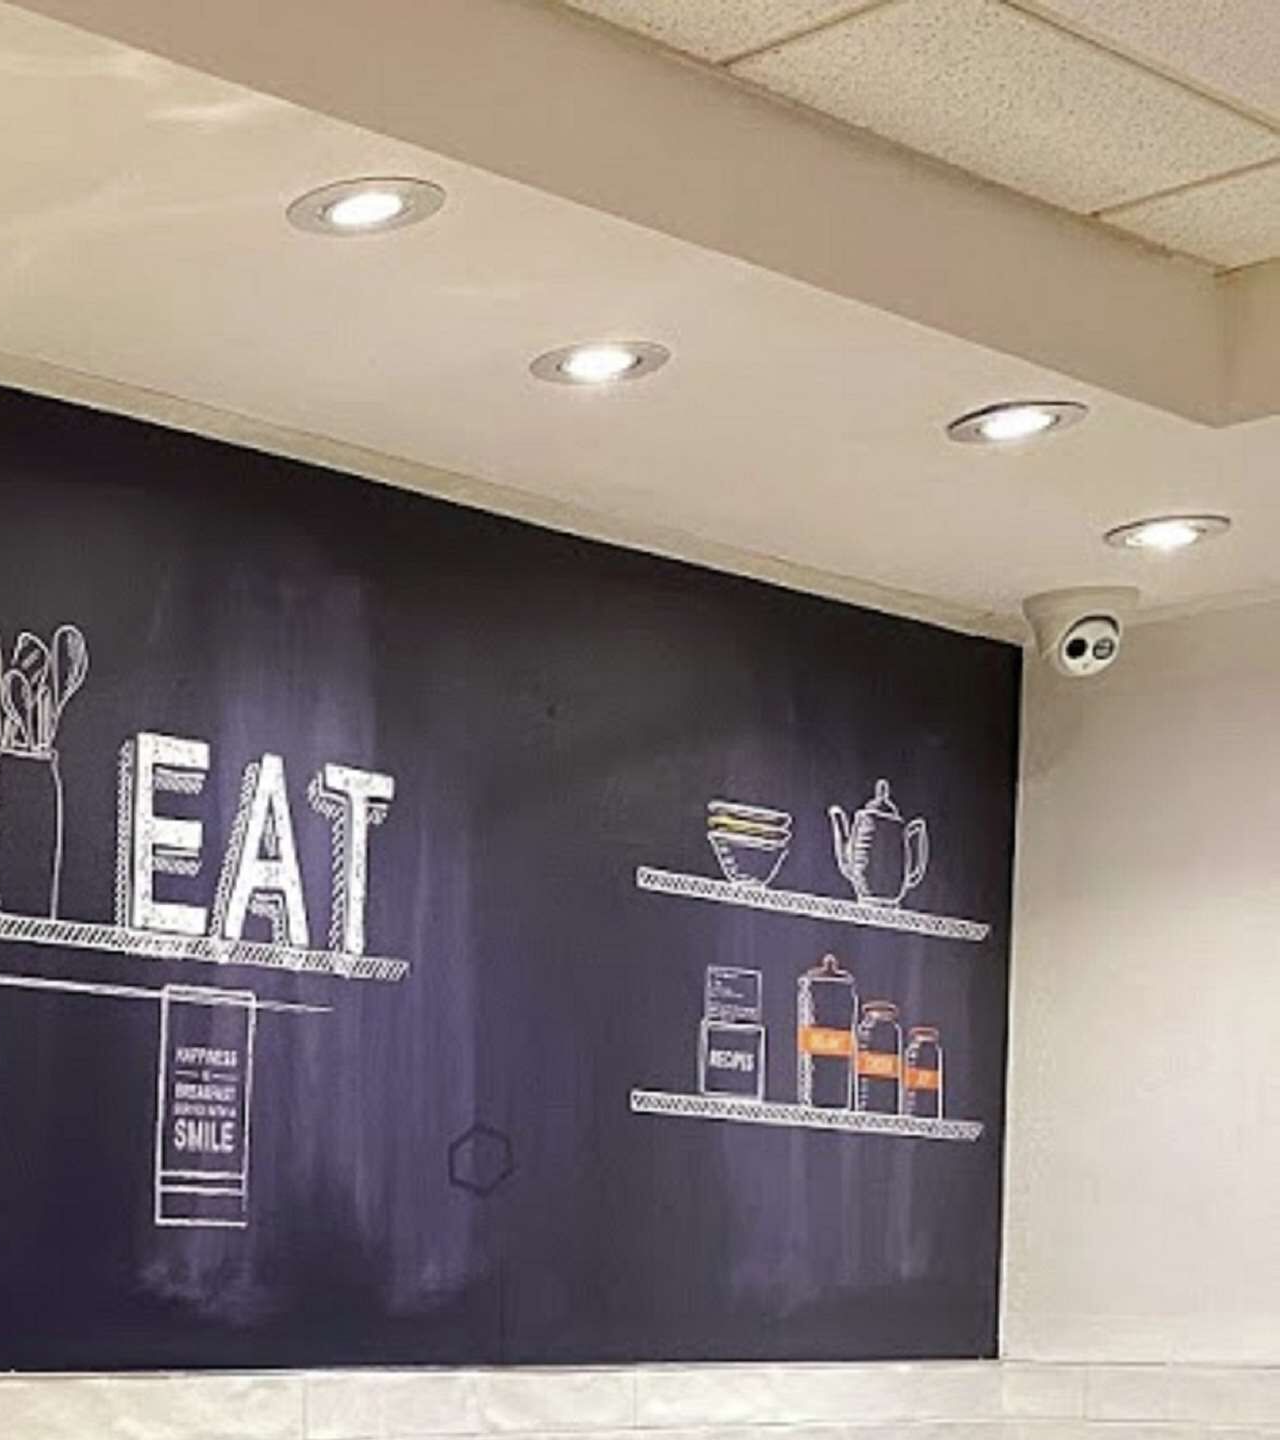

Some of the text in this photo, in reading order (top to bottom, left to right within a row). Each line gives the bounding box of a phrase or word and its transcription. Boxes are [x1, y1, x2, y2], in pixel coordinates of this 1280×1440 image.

[117, 731, 395, 956] EAT
[174, 1047, 238, 1067] HAPPINESS
[173, 1118, 236, 1153] SMILE
